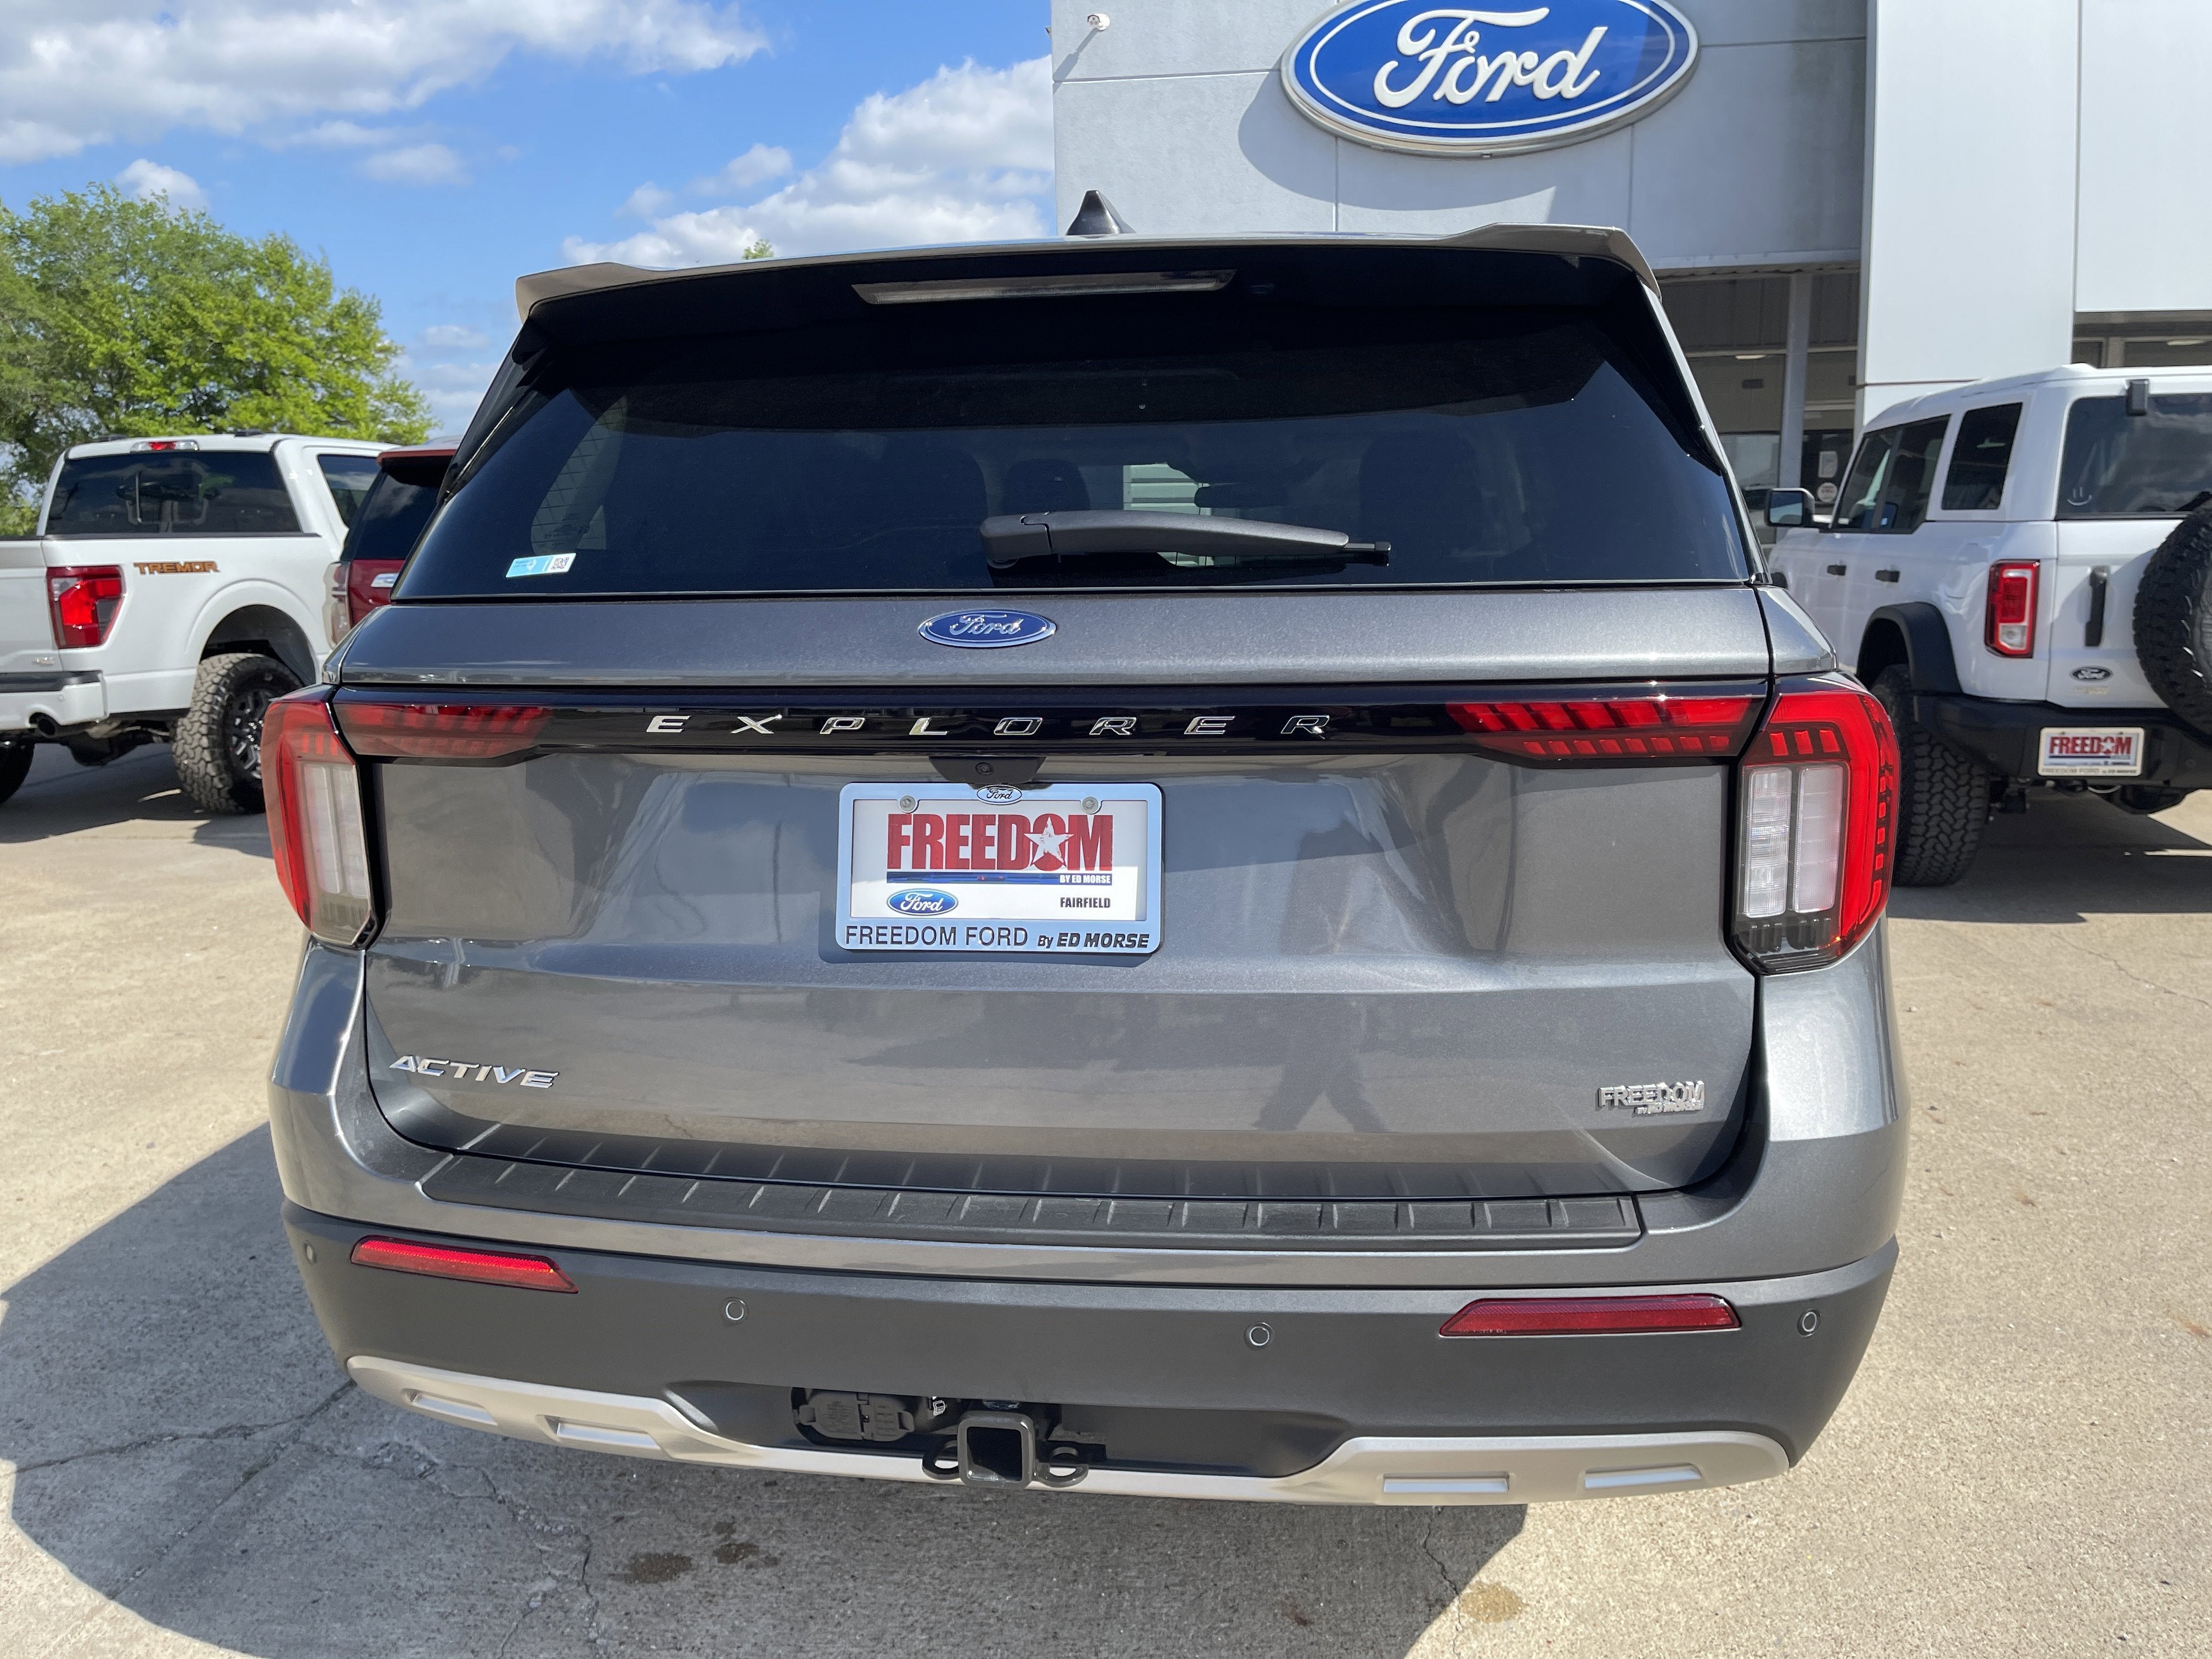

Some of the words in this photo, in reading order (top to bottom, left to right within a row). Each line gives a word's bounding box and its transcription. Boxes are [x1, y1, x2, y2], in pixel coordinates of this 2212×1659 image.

[1373, 7, 1609, 109] Ford
[133, 561, 221, 575] TREMOR
[950, 613, 1025, 636] Ford
[646, 714, 1331, 738] EXPLORER
[2050, 736, 2132, 755] FREEDOM
[986, 787, 1014, 799] Ford
[887, 813, 1114, 872] FREEDOM
[1059, 874, 1070, 883] BY
[1071, 874, 1082, 883] ED
[1083, 875, 1111, 884] MORSE
[900, 891, 944, 912] Ford
[1060, 897, 1111, 909] FAIRFIELD
[845, 926, 957, 946] FREEDOM
[965, 926, 1028, 946] FORD
[1057, 933, 1079, 947] ED
[1084, 933, 1150, 949] MORSE
[390, 1054, 560, 1088] ACTIVE
[1598, 1080, 1705, 1107] FREEDOM
